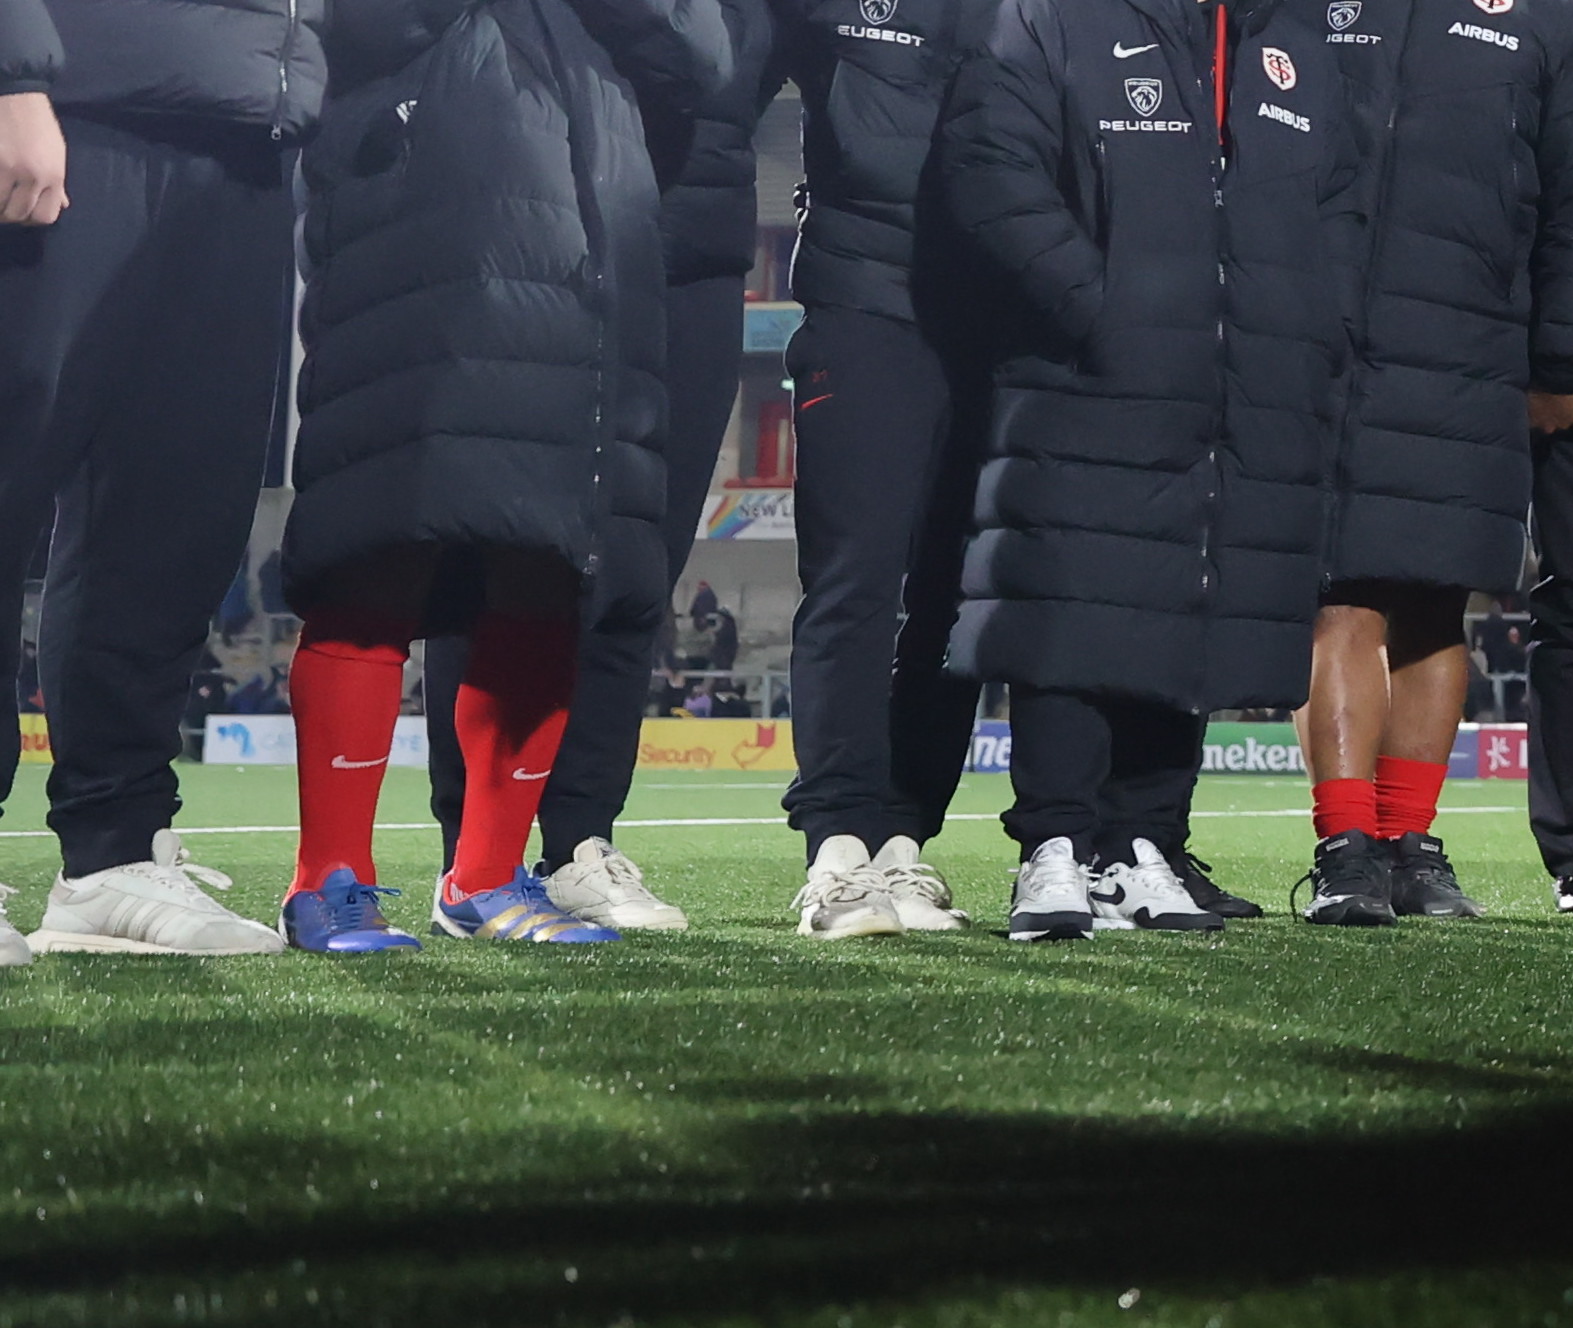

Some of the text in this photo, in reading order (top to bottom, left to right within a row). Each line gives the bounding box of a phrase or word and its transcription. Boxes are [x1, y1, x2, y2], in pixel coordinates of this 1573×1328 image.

[837, 25, 925, 47] EUGEOT
[1326, 33, 1382, 45] GEOT
[1448, 21, 1519, 51] AIRBUS
[1100, 119, 1193, 133] PEUGEOT
[1258, 102, 1311, 132] AIRBUS
[1202, 737, 1305, 771] neken
